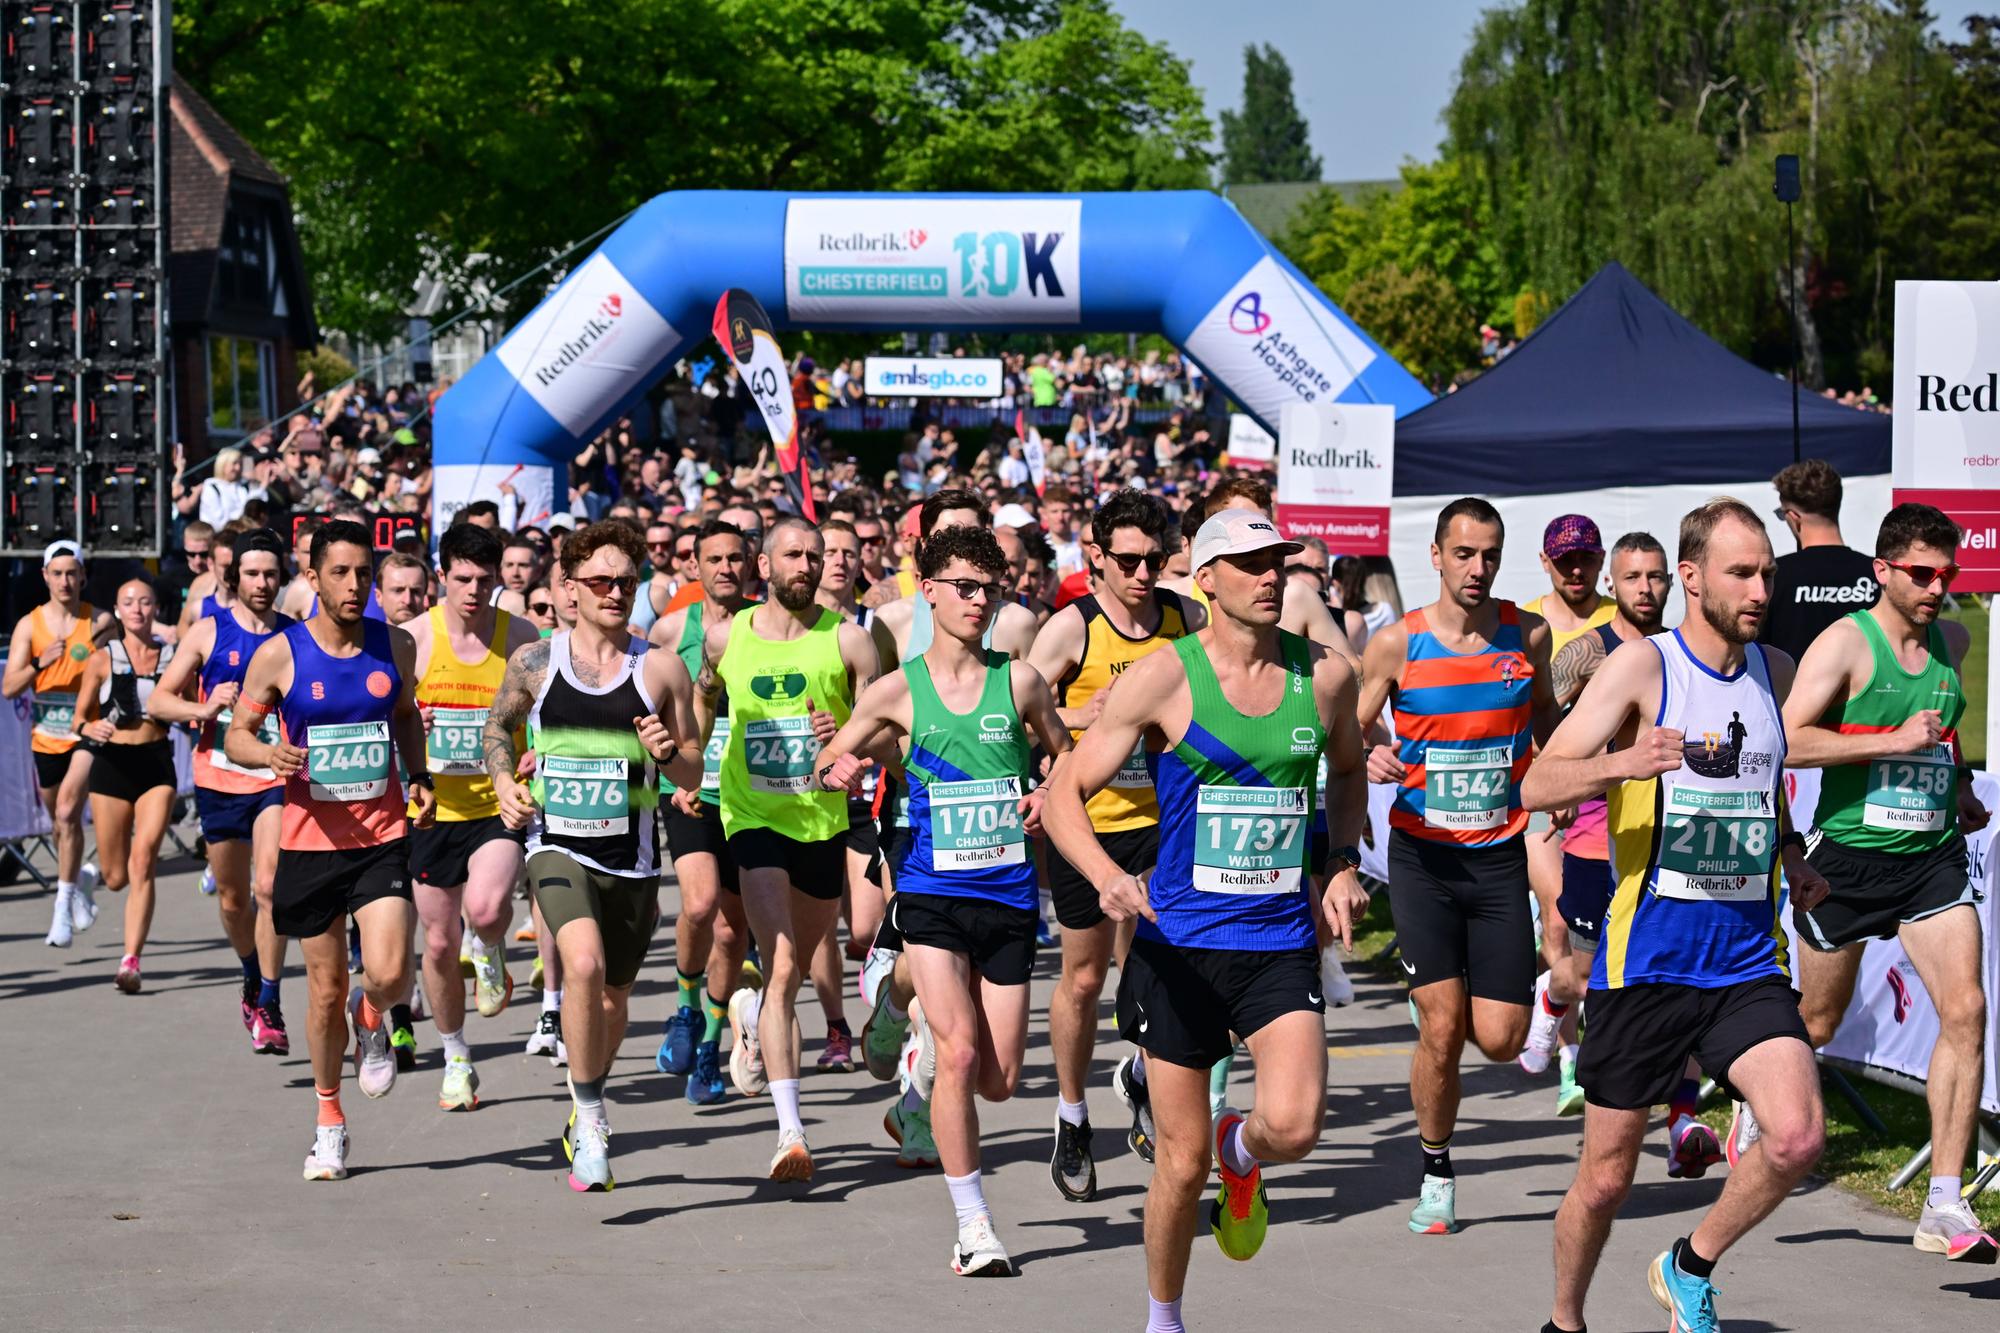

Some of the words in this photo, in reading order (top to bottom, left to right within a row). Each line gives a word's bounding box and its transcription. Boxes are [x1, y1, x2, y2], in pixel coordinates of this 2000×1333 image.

[952, 231, 1065, 297] 10K
[803, 273, 943, 291] CHESTERFIELD
[1252, 340, 1316, 402] Hospice
[1266, 331, 1331, 393] Ashgate
[751, 366, 778, 401] 40
[764, 402, 782, 417] ins
[1291, 448, 1382, 469] Redbrik.
[1287, 521, 1325, 536] You're
[1326, 523, 1380, 540] Amazing!
[456, 683, 497, 694] DERBYSHI
[311, 727, 362, 739] CHESTERFIELD
[363, 723, 385, 738] 10K
[749, 720, 800, 732] CHESTERFIELD
[313, 743, 385, 772] 2440
[450, 751, 474, 760] LUKE
[750, 737, 821, 765] 2429
[1430, 752, 1487, 763] CHESTERFIELD
[1488, 747, 1509, 765] 10K
[548, 760, 599, 770] CHESTERFIELD
[602, 760, 624, 773] 10K
[1740, 757, 1771, 767] EUROPE
[934, 785, 992, 796] CHESTERFIELD
[993, 779, 1017, 795] 10K
[1434, 770, 1507, 799] 1542
[1878, 763, 1950, 796] 1258
[548, 778, 624, 806] 2376
[1204, 792, 1275, 804] CHESTERFIELD
[1279, 789, 1305, 807] 10K
[1674, 791, 1743, 807] CHESTERFIELD
[1746, 790, 1770, 809] 10K
[1457, 800, 1482, 811] PHIL
[1900, 796, 1927, 808] RICH
[939, 802, 1018, 835] 1704
[956, 834, 1003, 848] CHARLIE
[1207, 816, 1301, 851] 1737
[1670, 816, 1768, 857] 2118
[1228, 854, 1273, 867] WATTO
[1696, 859, 1740, 873] PHILIP
